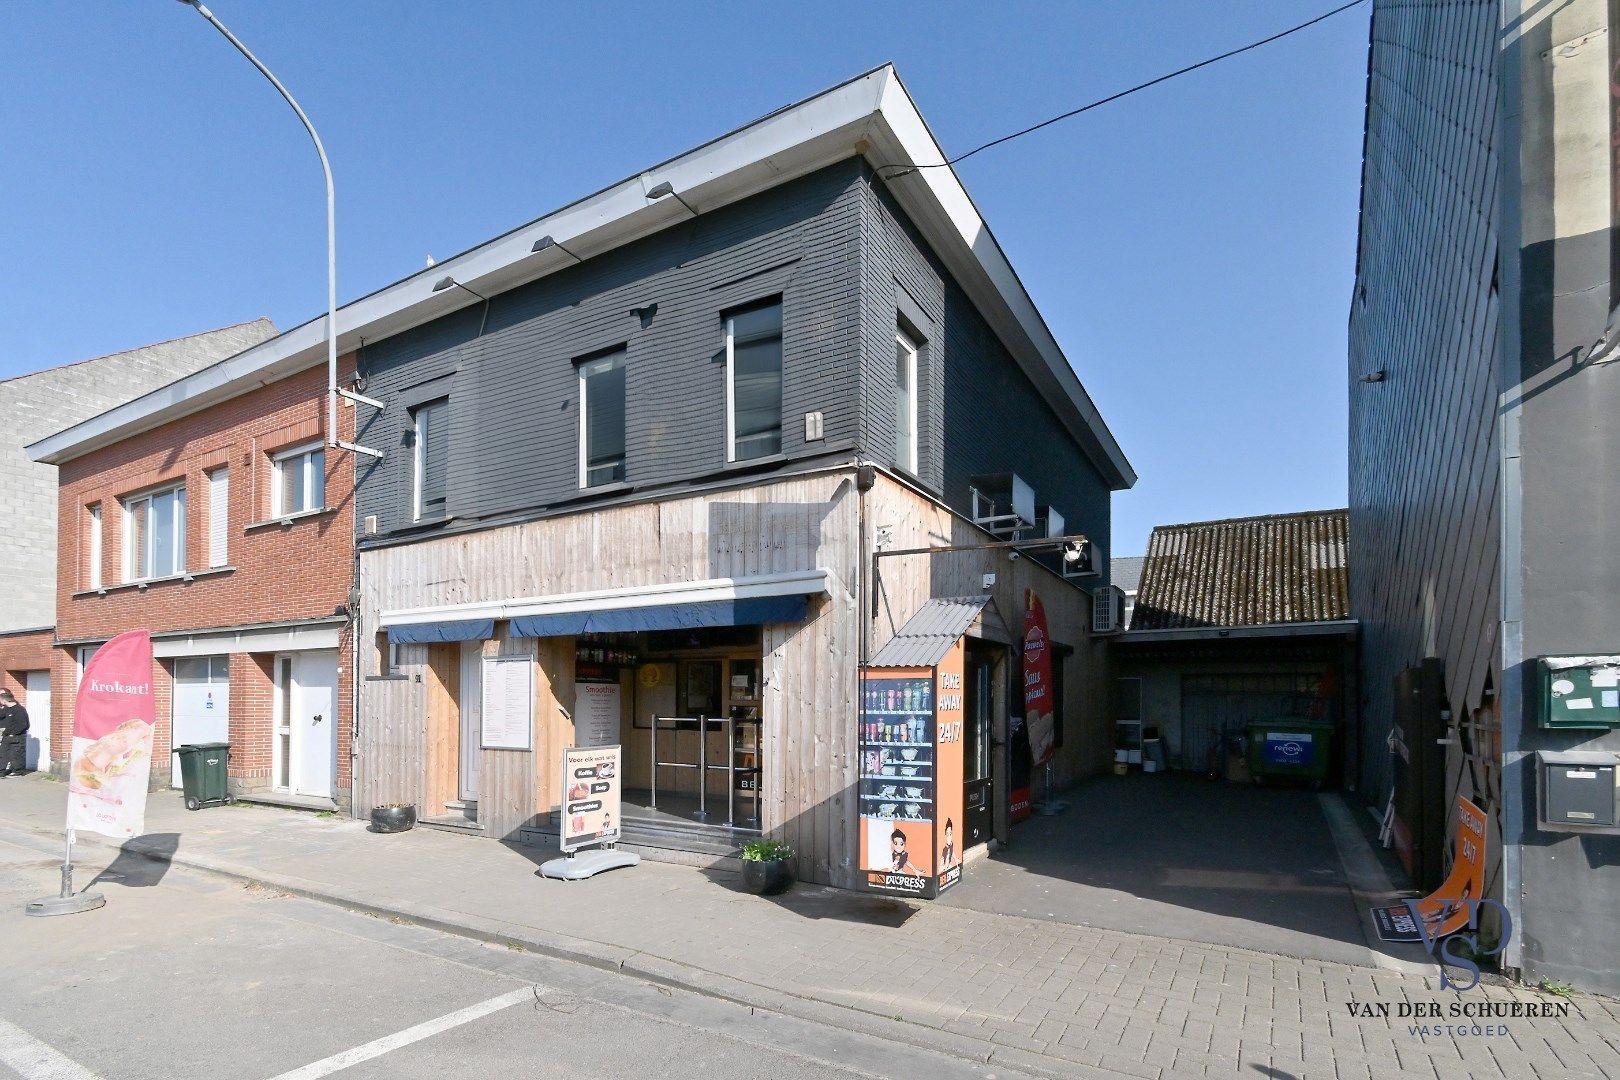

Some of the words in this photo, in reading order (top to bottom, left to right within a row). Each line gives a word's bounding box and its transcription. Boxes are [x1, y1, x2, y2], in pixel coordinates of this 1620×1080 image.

[91, 679, 149, 695] Krokant!
[939, 672, 960, 689] TAKE
[585, 685, 616, 694] Smoothie
[939, 694, 961, 711] AWAY
[939, 720, 961, 743] 24/7
